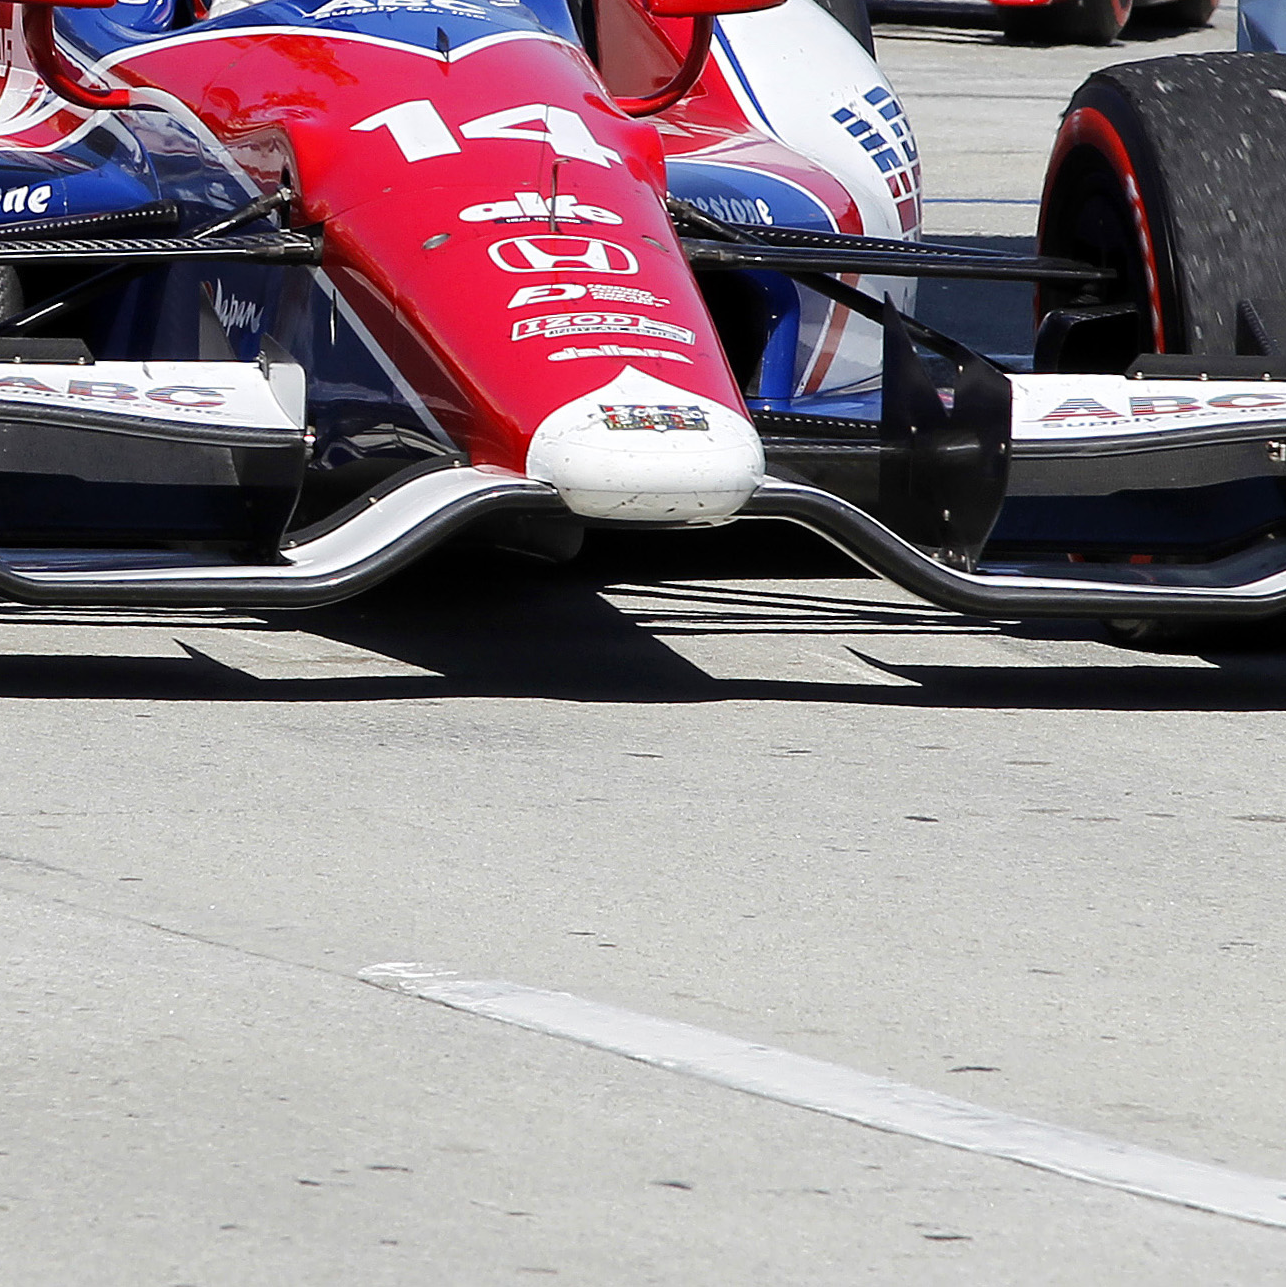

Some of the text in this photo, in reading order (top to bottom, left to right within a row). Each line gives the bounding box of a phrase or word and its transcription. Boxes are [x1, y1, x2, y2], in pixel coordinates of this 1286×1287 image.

[349, 100, 624, 169] 14
[525, 315, 632, 333] IZOD
[547, 344, 694, 364] dallara
[1042, 413, 1162, 429] Supply
